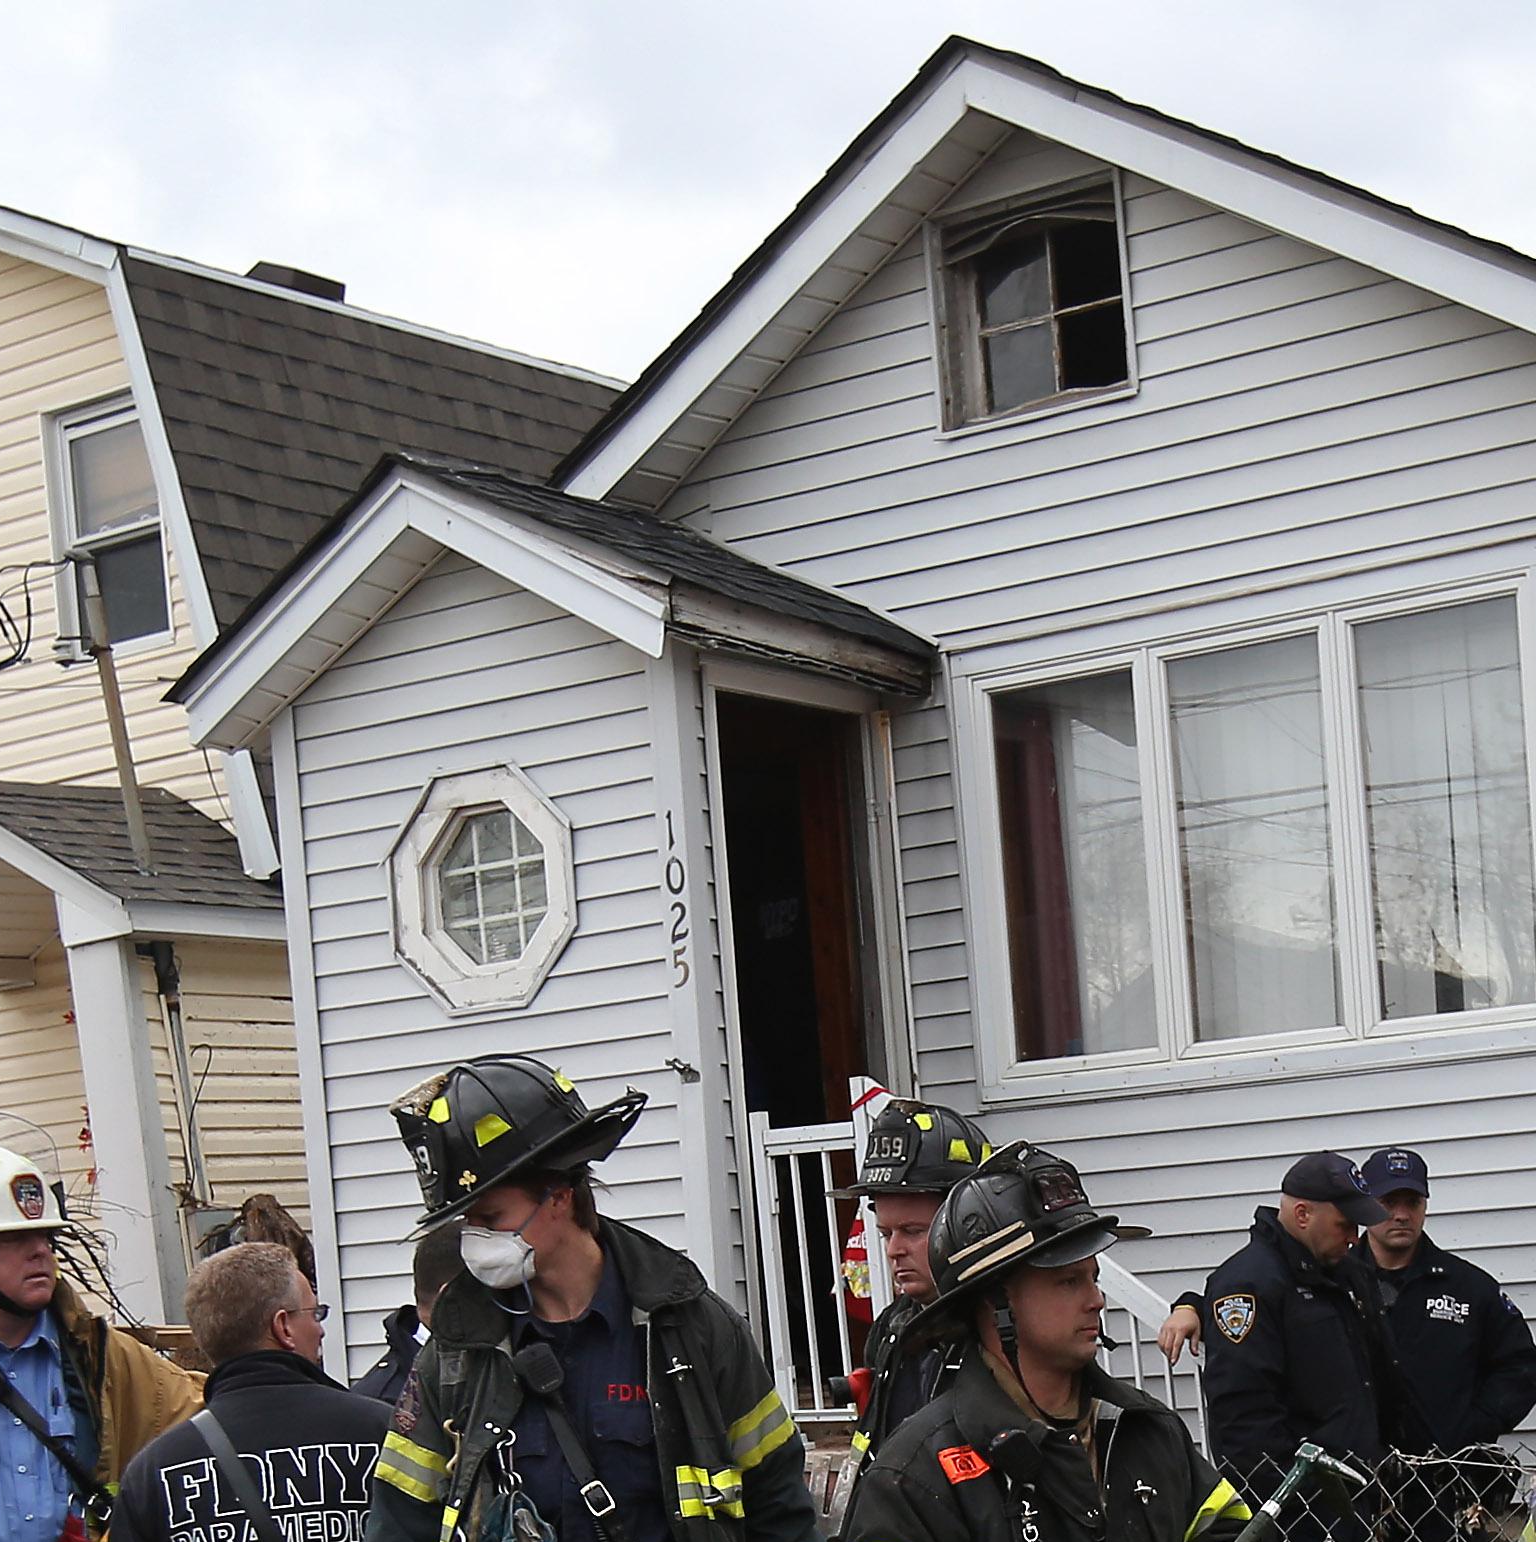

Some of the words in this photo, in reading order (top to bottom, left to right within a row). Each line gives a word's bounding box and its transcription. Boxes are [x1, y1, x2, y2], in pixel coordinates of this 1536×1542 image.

[665, 809, 690, 989] 1025
[869, 1136, 904, 1159] 159
[1426, 1298, 1470, 1316] POLICE
[160, 1442, 381, 1530] FDNY
